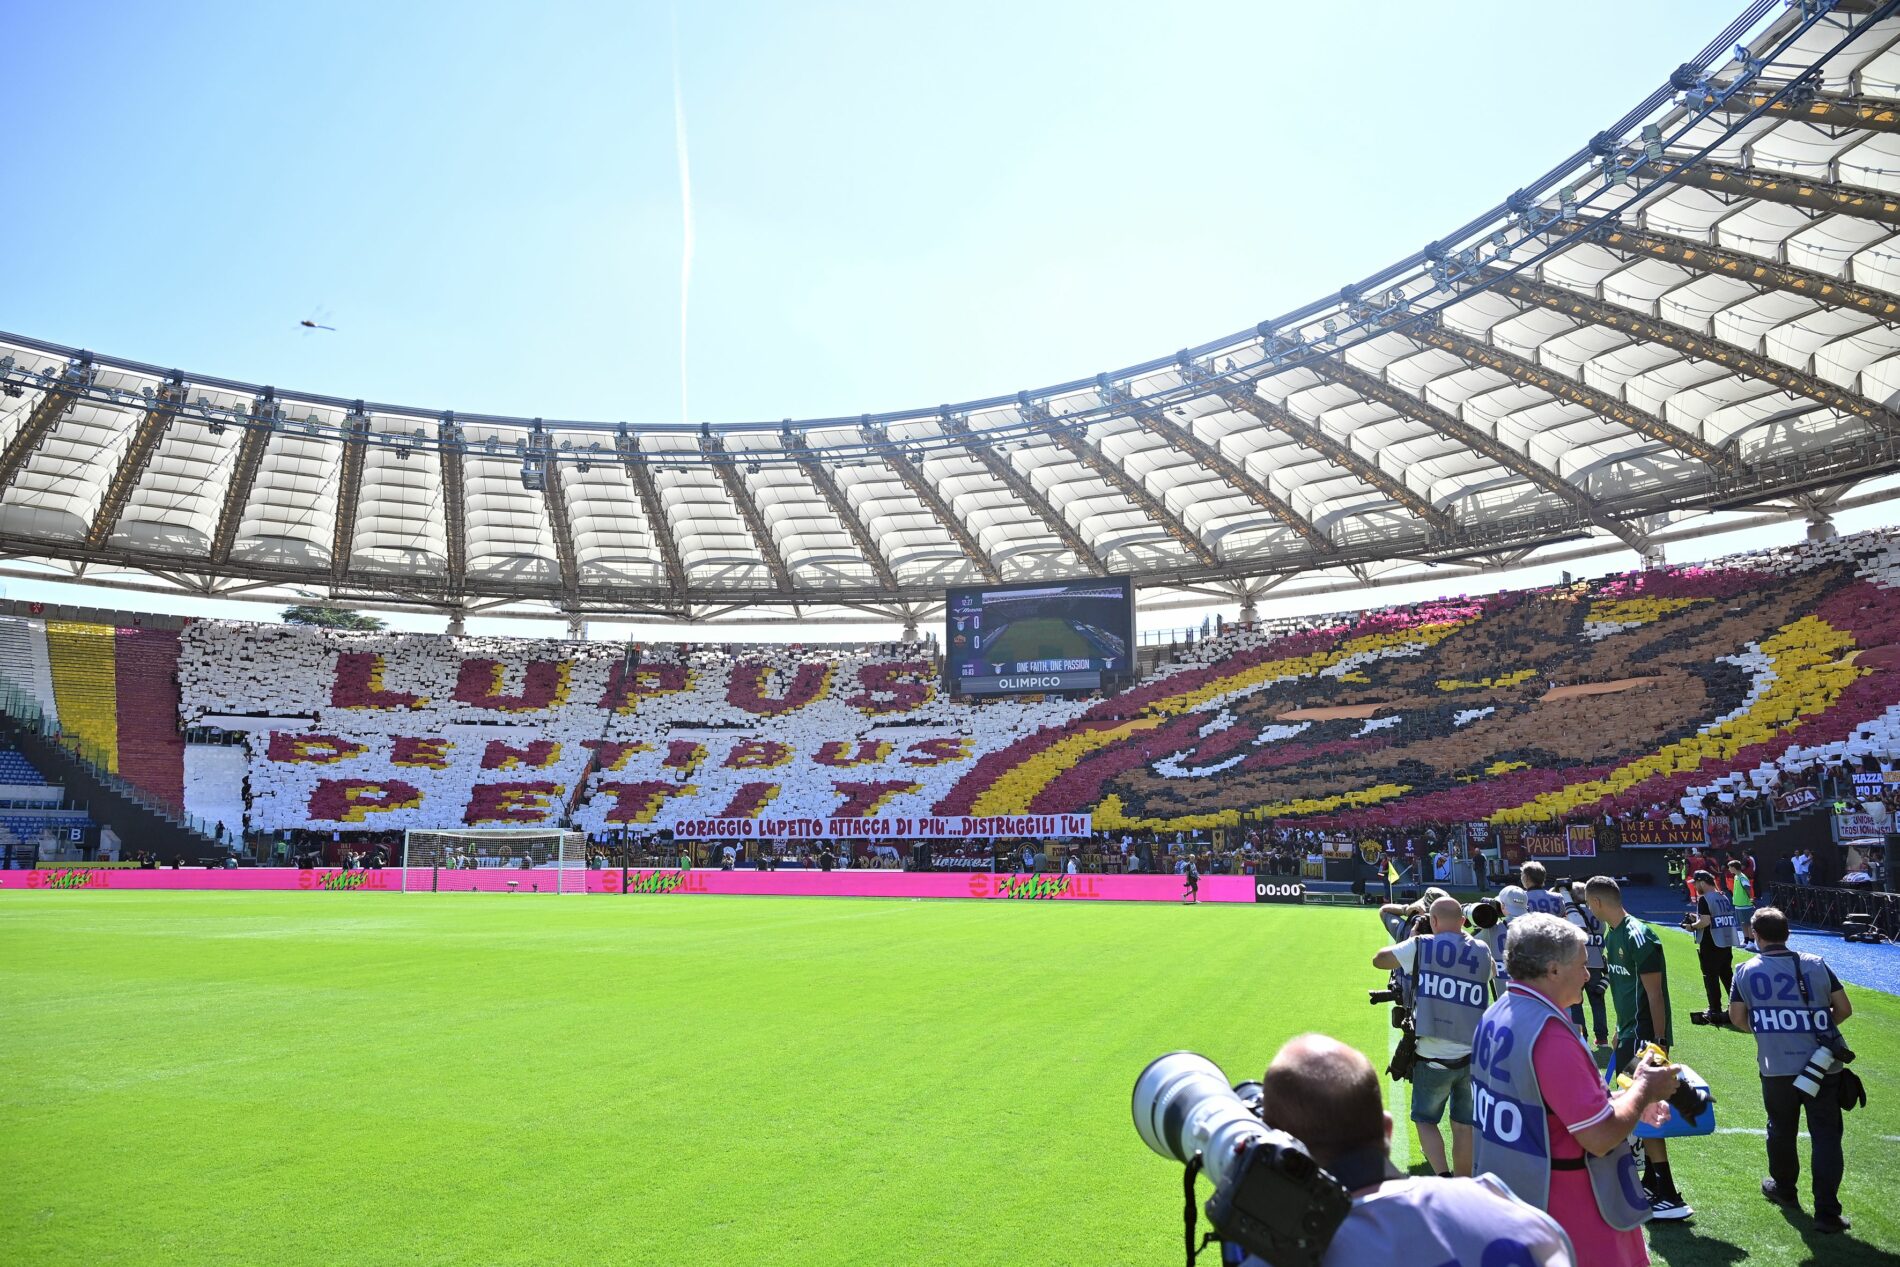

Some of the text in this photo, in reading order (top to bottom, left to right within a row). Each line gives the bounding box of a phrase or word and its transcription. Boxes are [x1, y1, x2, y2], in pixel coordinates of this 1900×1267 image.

[973, 615, 980, 630] 0
[973, 635, 980, 649] 0
[1016, 659, 1090, 673] ONE FAITH, ONE PASSION
[999, 676, 1061, 689] OLIMPICO
[1852, 773, 1883, 784] PIAZZA
[1786, 789, 1816, 807] PISA
[675, 819, 753, 837] CORAGGIO
[758, 818, 824, 837] LUPETTO
[829, 817, 890, 836] ATTACCA
[896, 817, 912, 835] DI
[1060, 815, 1085, 835] TU!
[70, 828, 81, 841] B
[1256, 883, 1300, 896] 00:00
[1420, 937, 1480, 975] 104
[1607, 963, 1631, 976] YOTA
